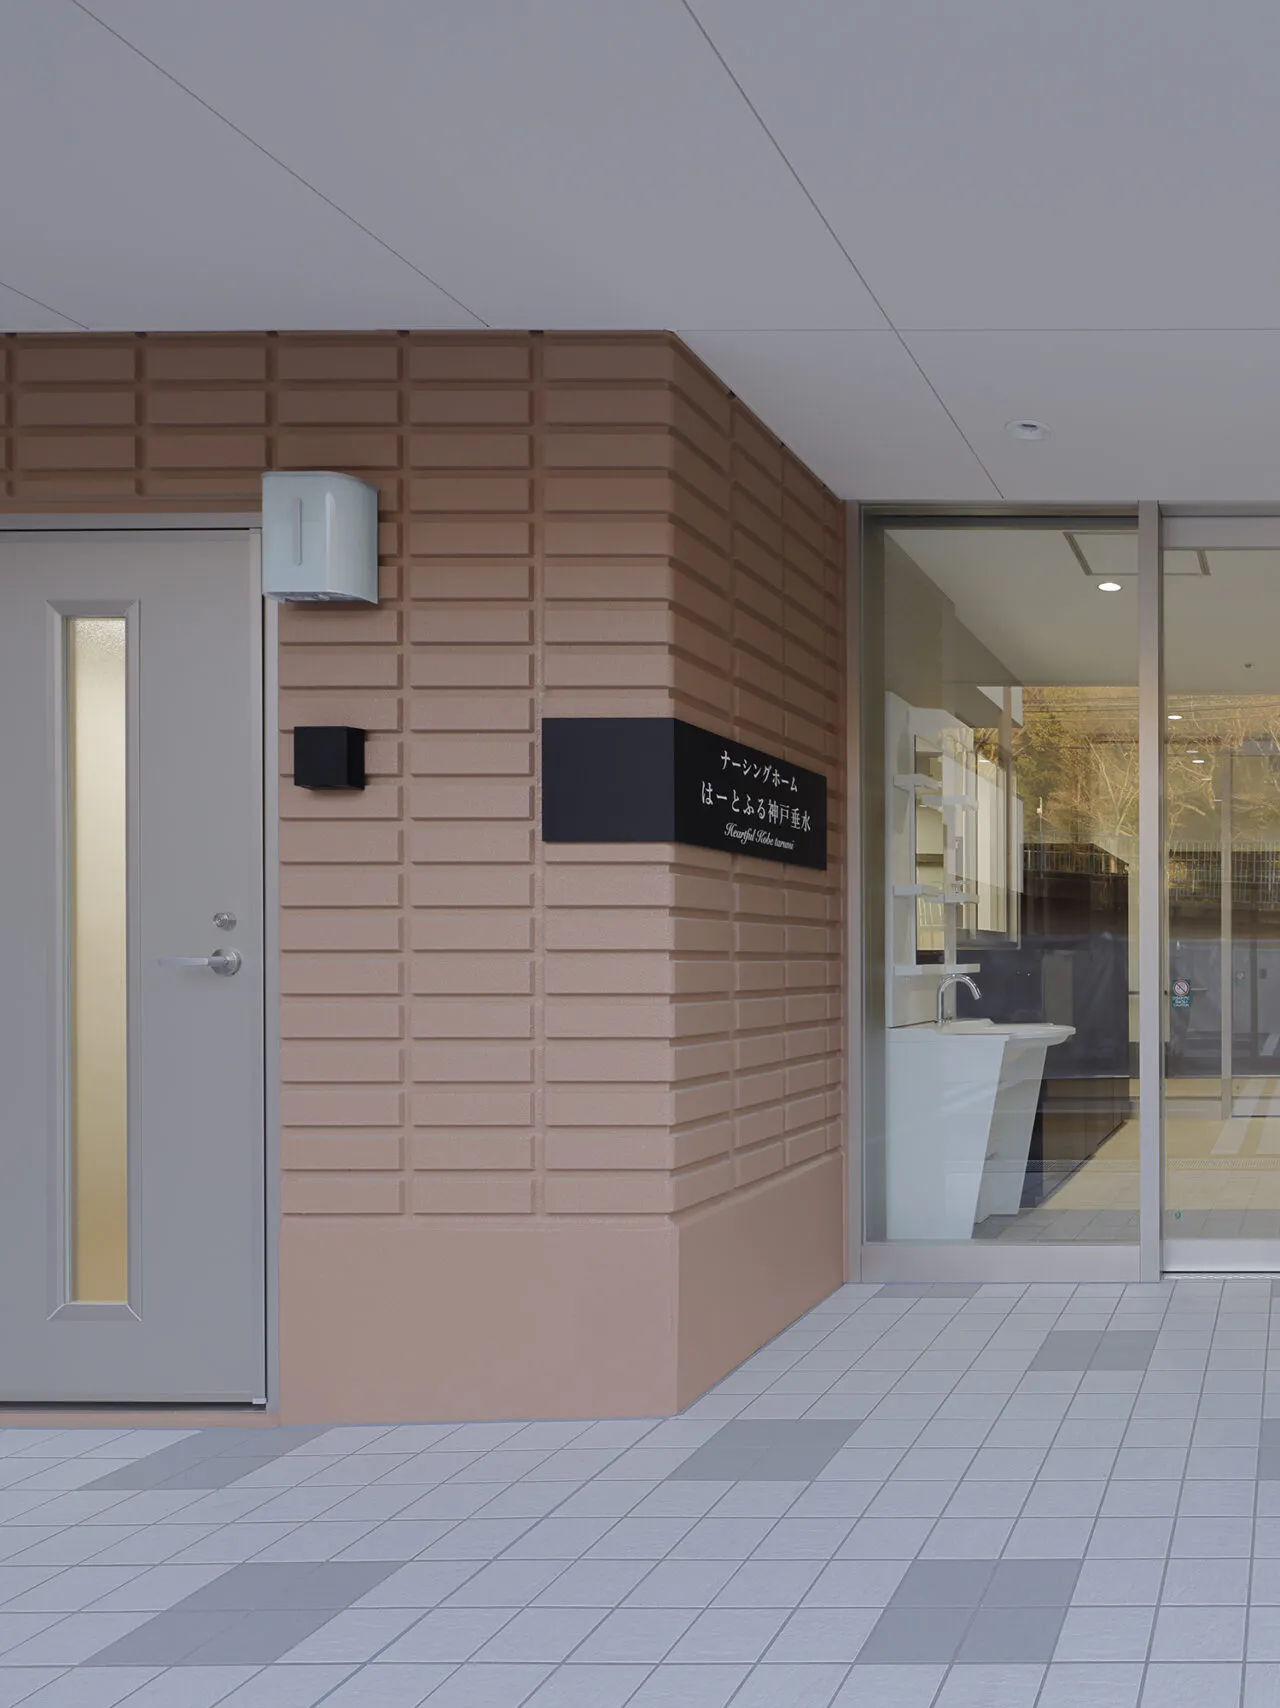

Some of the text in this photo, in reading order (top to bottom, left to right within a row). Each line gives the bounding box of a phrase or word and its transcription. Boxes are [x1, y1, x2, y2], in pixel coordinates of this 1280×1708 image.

[720, 750, 799, 792] ナーシングホーム
[701, 780, 811, 832] はーとふる神戸垂水
[724, 822, 756, 845] Heartful
[755, 829, 774, 845] Kobe
